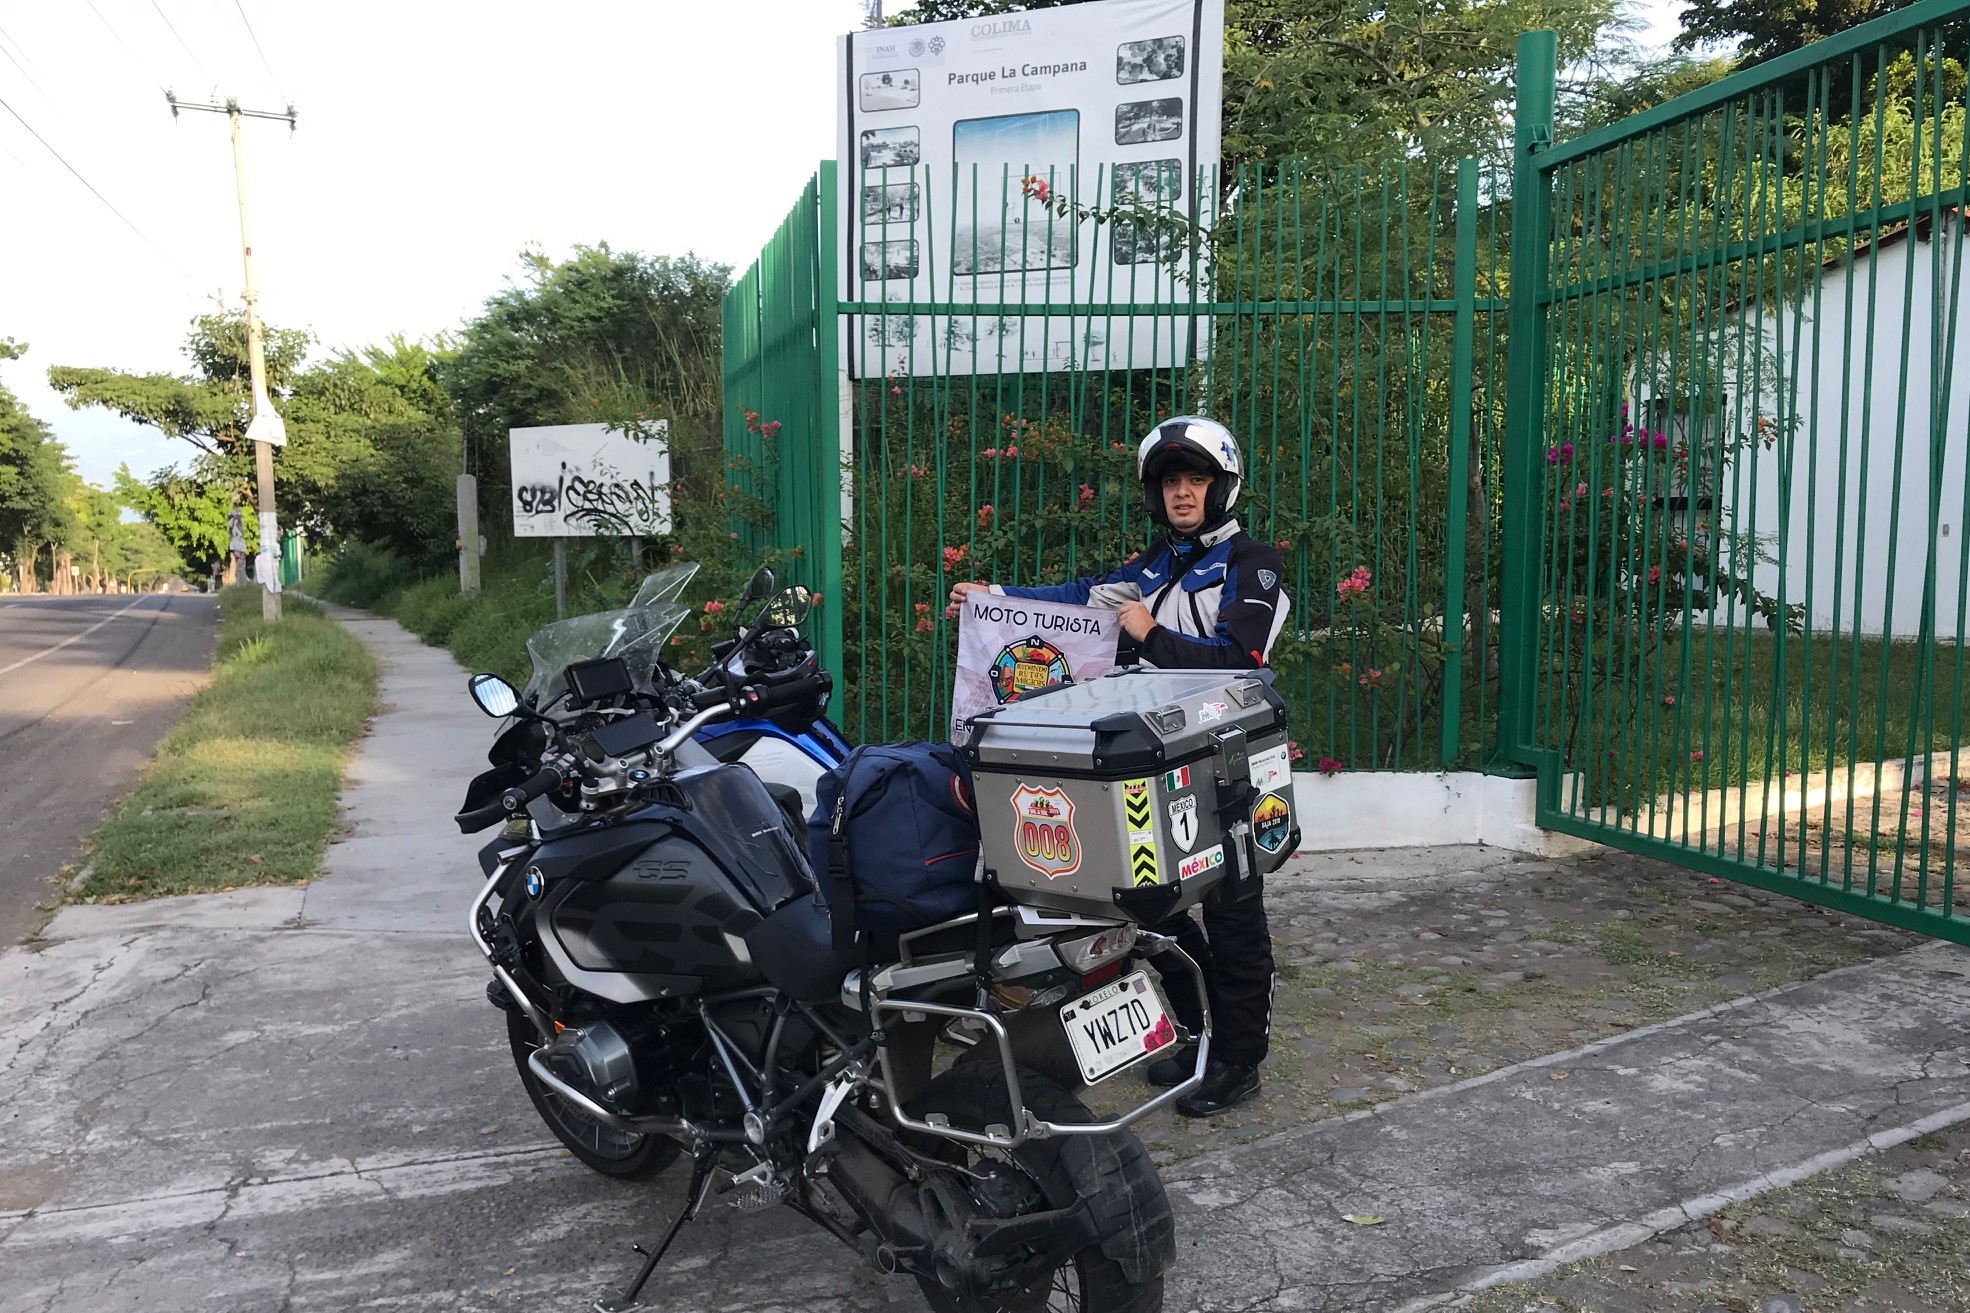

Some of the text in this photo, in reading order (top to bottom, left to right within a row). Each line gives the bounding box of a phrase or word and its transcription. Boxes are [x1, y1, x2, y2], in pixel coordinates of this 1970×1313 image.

[970, 19, 1032, 38] COLIMA
[876, 44, 896, 53] INAH
[948, 61, 1088, 86] Parque La Campana
[990, 83, 1042, 95] Primera Etapa
[973, 604, 1102, 636] MOTO TURISTA
[1018, 671, 1045, 680] RUTAS
[1179, 811, 1190, 842] 1
[1023, 821, 1072, 863] 008
[632, 860, 691, 881] GS
[1088, 985, 1119, 1005] ORELO
[1083, 998, 1151, 1054] YWZ7D
